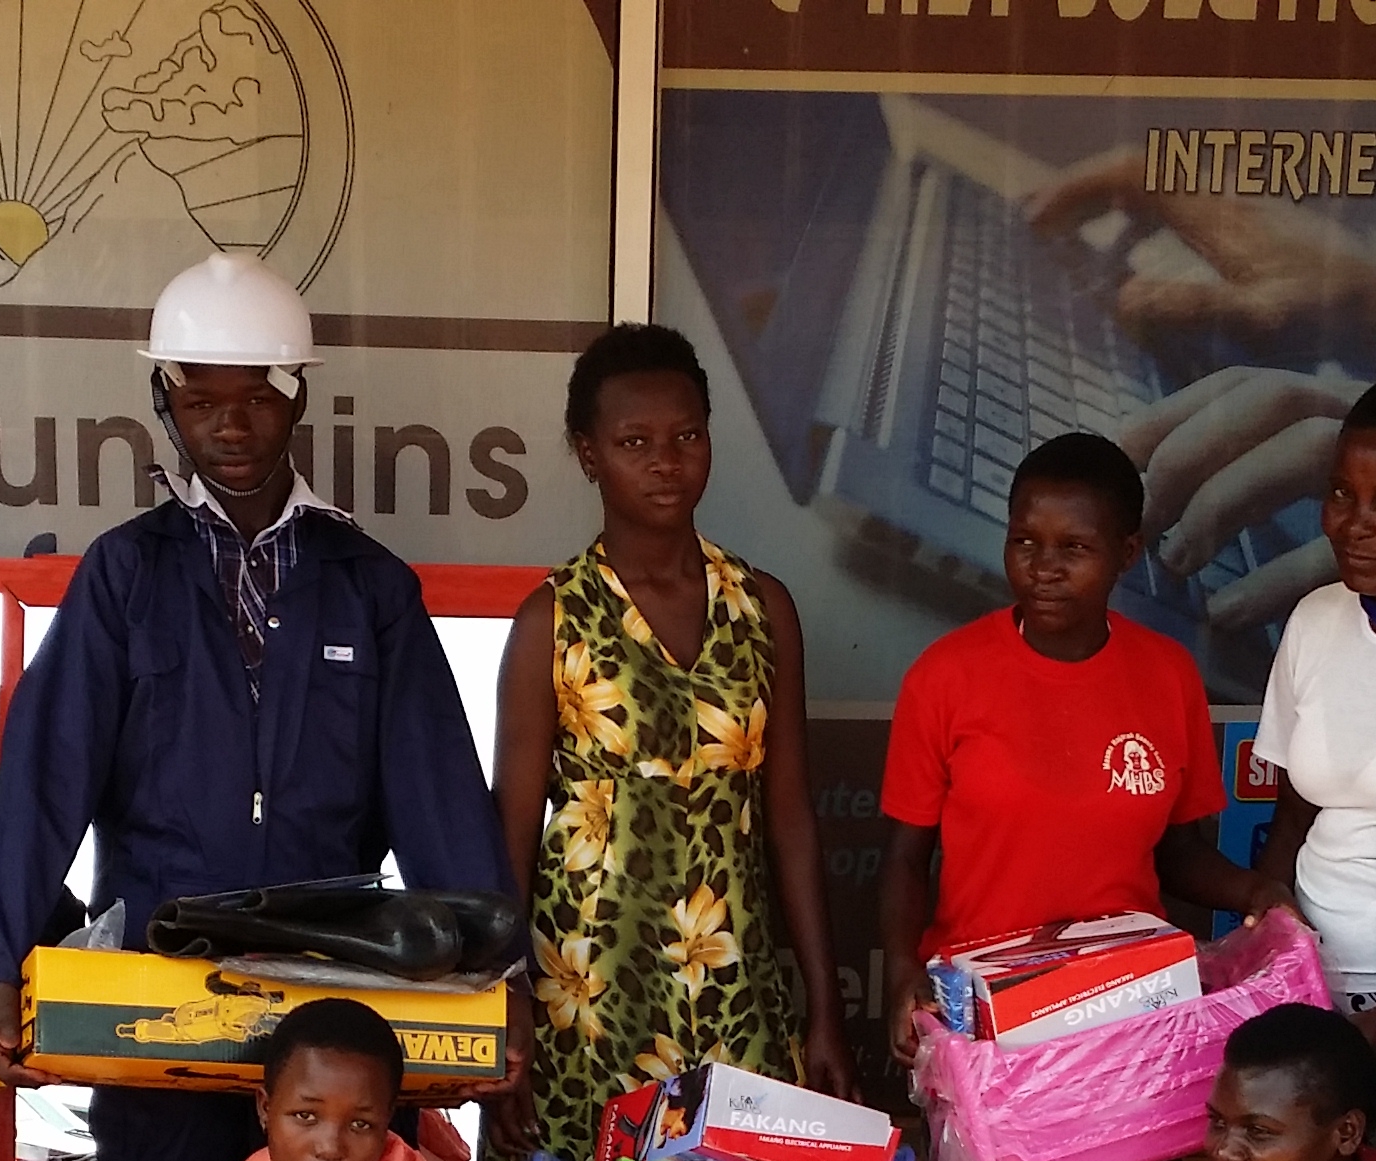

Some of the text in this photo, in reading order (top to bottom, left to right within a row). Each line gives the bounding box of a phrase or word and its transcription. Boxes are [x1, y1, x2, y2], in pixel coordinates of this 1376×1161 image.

[1106, 768, 1165, 795] MHBS
[1064, 971, 1172, 1026] FAKANG
[730, 1111, 827, 1136] FAKANG
[785, 1138, 818, 1149] ELECTRICAL
[819, 1142, 852, 1152] APPLIANCE
